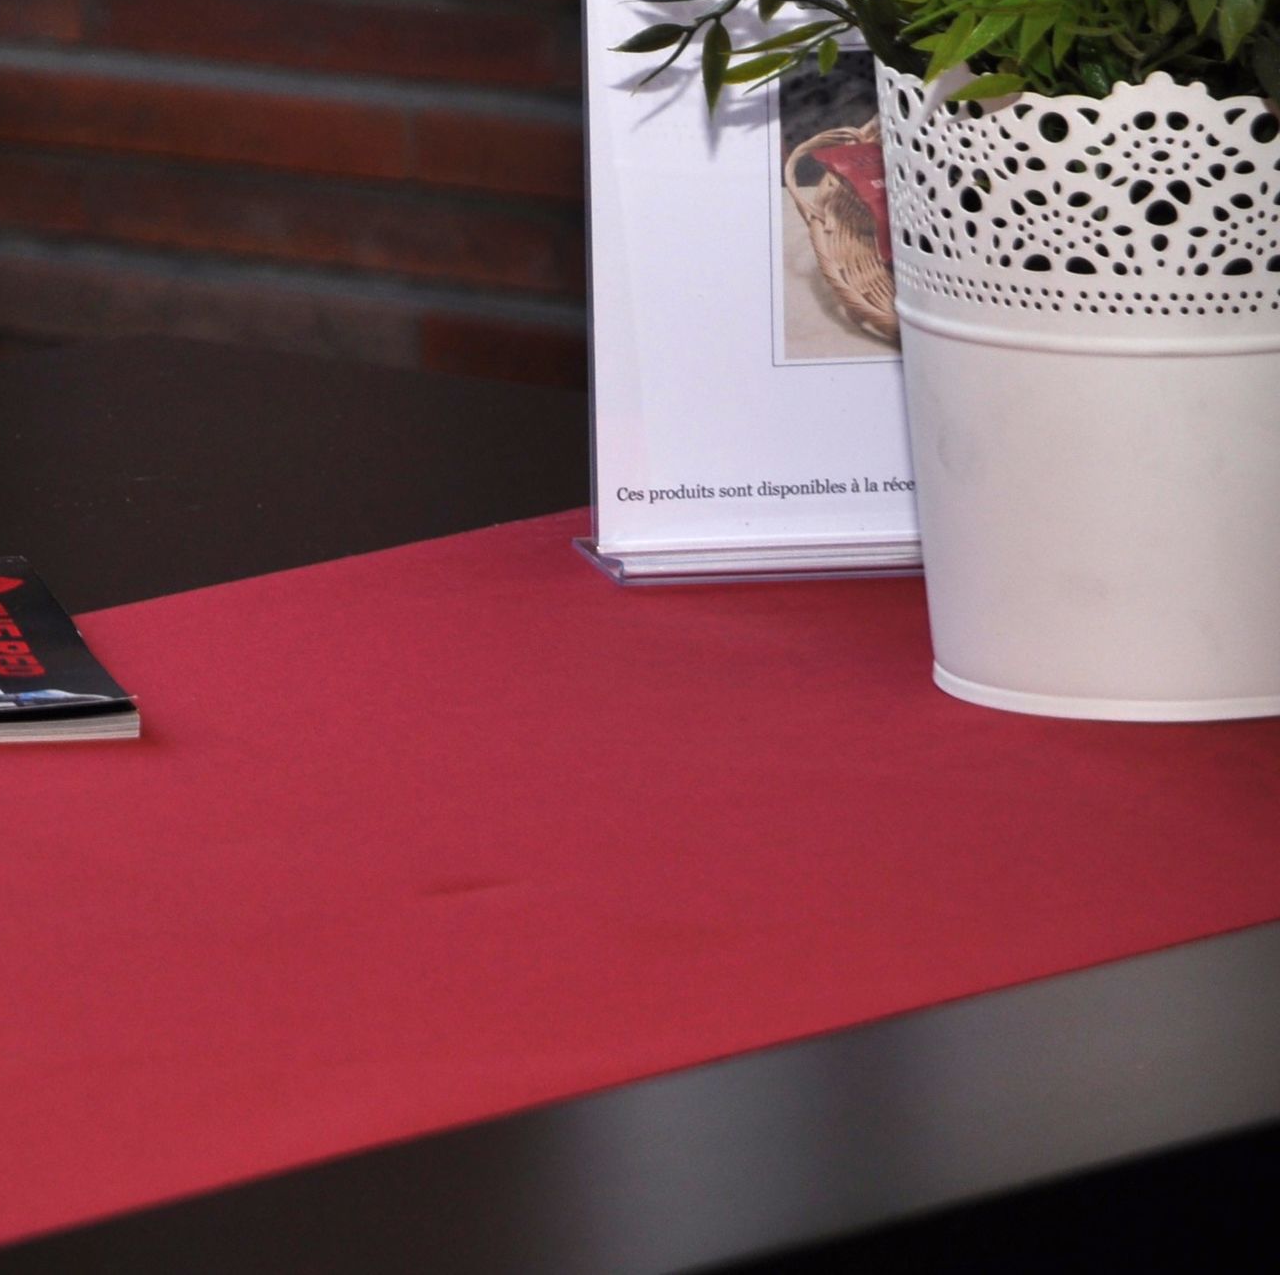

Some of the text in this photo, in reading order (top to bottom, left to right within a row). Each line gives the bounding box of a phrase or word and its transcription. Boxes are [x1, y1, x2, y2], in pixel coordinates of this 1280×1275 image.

[616, 487, 644, 502] Ces
[649, 483, 715, 504] produits
[718, 483, 753, 498] sont
[757, 478, 847, 499] disponibles
[851, 478, 860, 493] à
[864, 478, 879, 492] la
